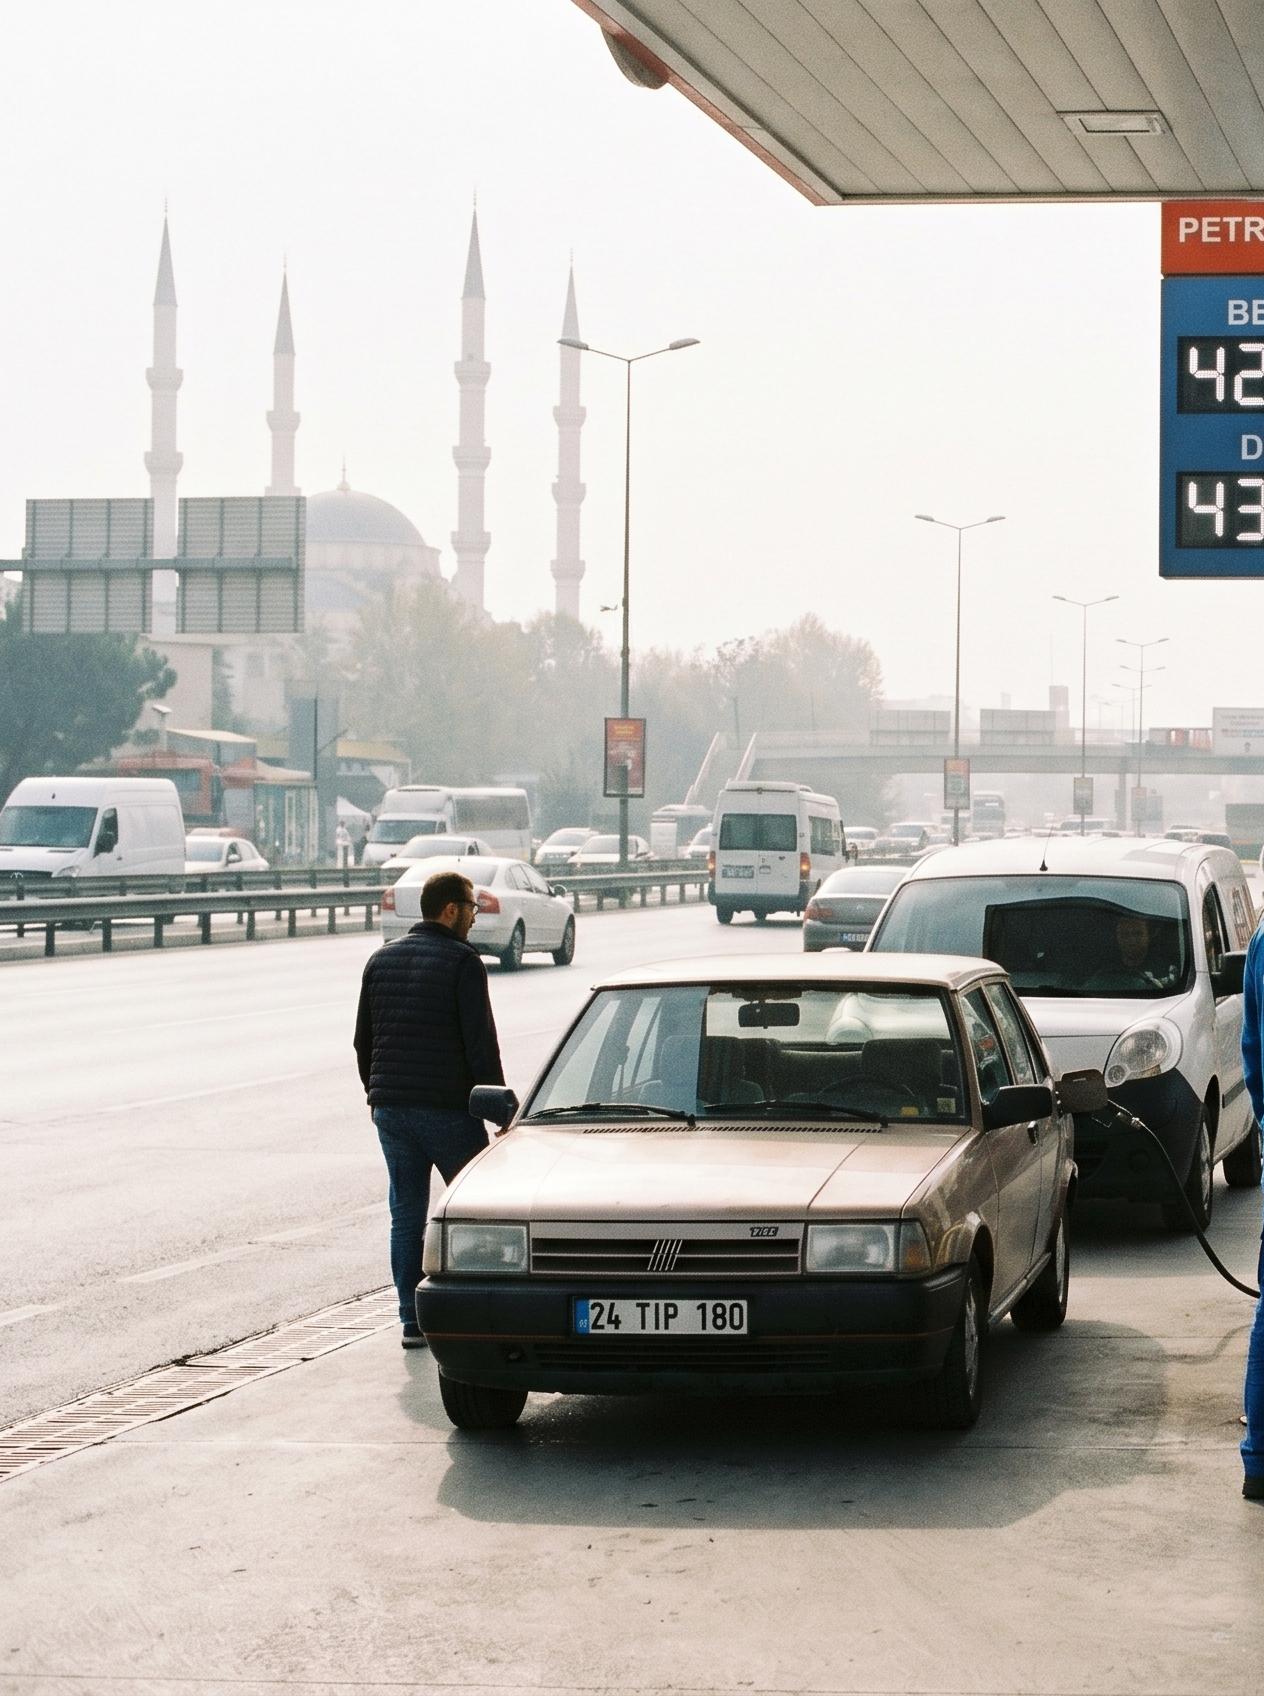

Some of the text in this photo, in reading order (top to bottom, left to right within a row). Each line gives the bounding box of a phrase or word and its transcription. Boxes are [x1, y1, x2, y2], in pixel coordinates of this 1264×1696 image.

[590, 1301, 744, 1331] 24 TIP 180
